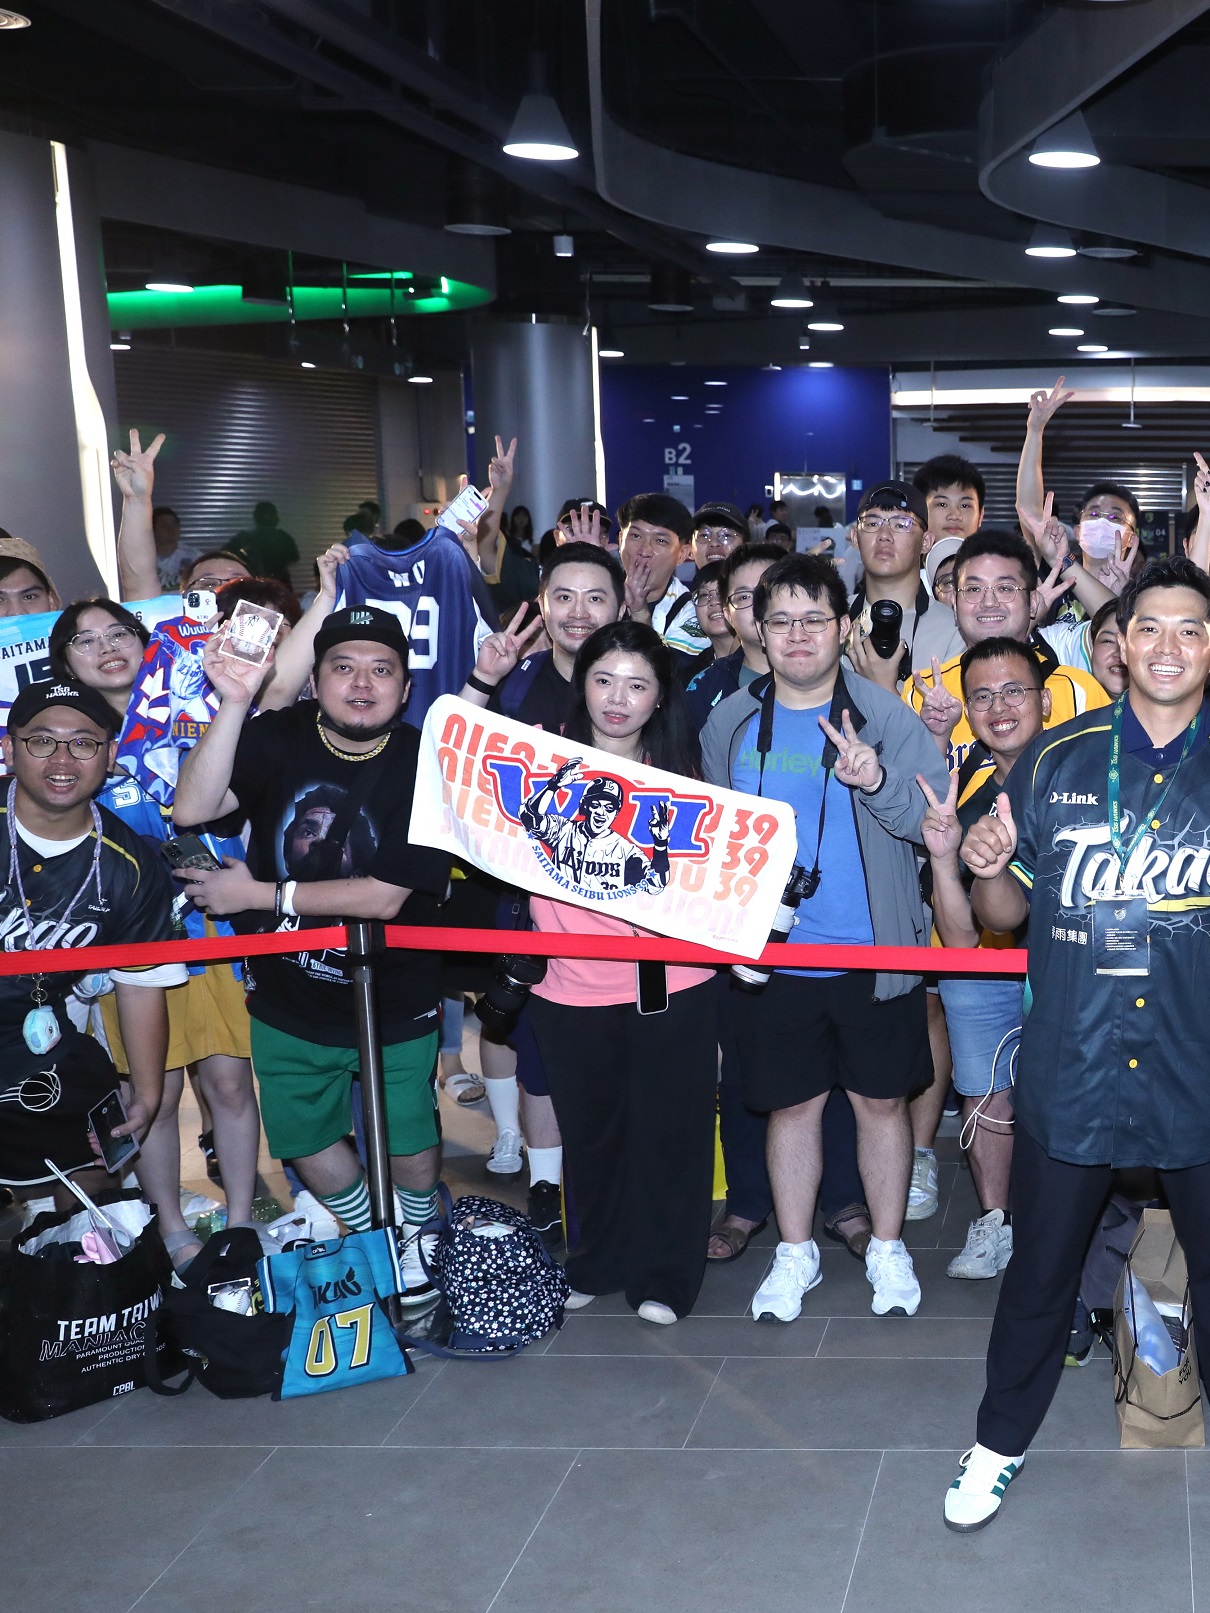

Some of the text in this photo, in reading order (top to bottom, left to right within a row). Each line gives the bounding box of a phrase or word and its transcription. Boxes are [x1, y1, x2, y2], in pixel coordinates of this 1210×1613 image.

[664, 443, 692, 464] B2
[1, 636, 51, 660] AITAM
[728, 808, 779, 847] 39
[532, 845, 570, 890] SAITAMA
[571, 884, 605, 901] SEIBU
[607, 887, 638, 901] LIONS
[721, 841, 770, 878] 39
[713, 870, 759, 908] 39
[39, 1320, 147, 1362] MANIAC
[57, 1313, 117, 1341] TEAM
[304, 1303, 375, 1377] 07
[76, 1342, 123, 1360] PARAMOUNT
[81, 1358, 125, 1373] AUTHENTIC
[125, 1351, 142, 1364] DRY
[1178, 1365, 1192, 1386] YOU
